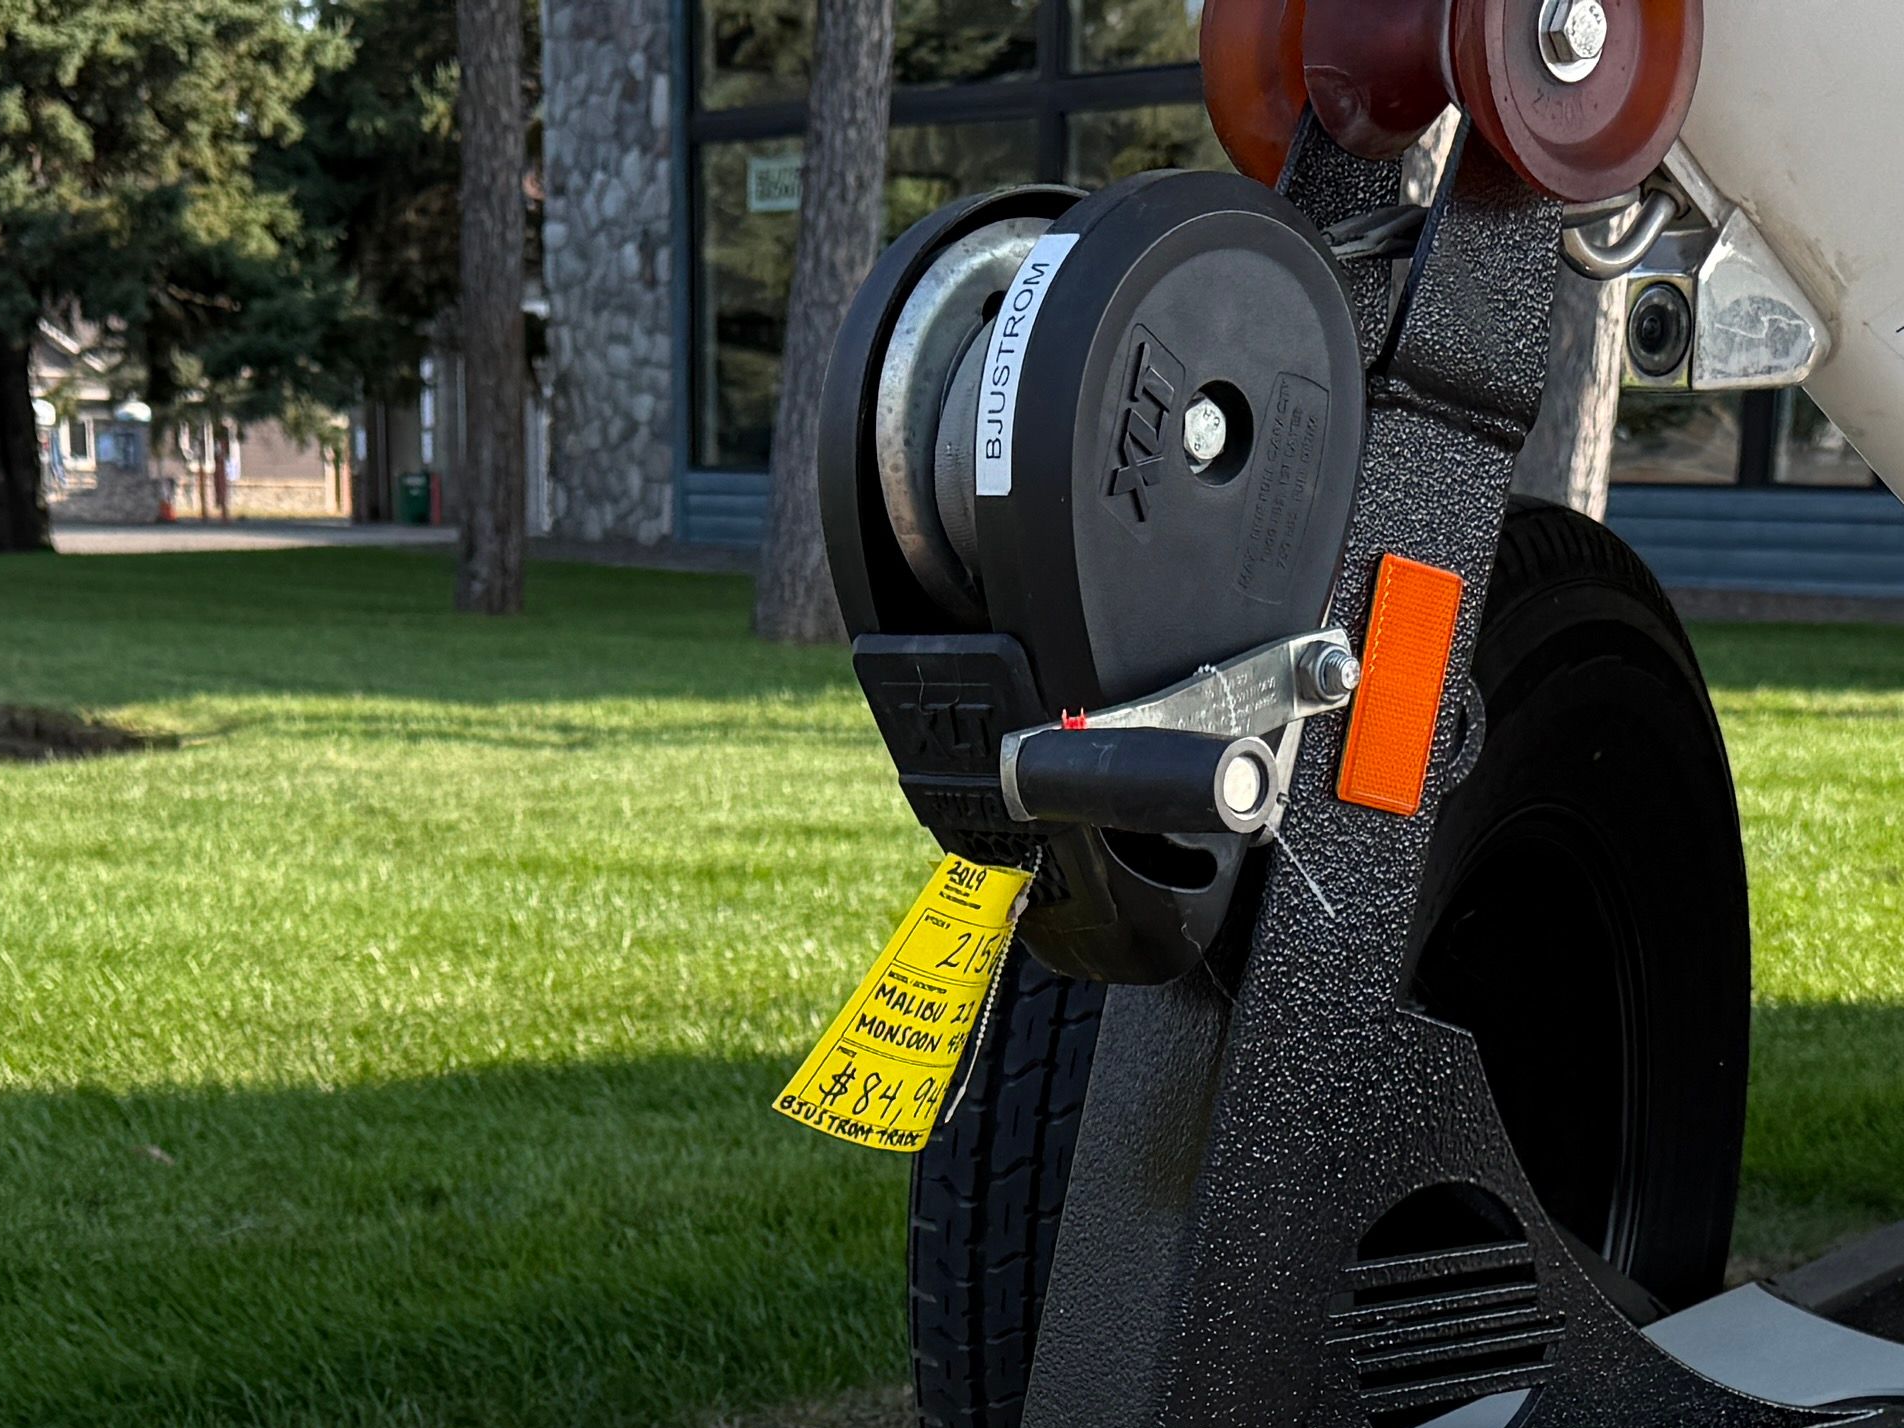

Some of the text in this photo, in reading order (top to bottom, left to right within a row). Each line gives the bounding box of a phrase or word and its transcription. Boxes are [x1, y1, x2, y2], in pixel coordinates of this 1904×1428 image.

[985, 260, 1051, 460] BJUSTROM
[1111, 339, 1175, 523] XLT
[947, 860, 987, 892] 2019
[874, 982, 949, 1024] MALIBU
[855, 1013, 944, 1054] MONSOON
[818, 1060, 947, 1127] $84,94
[778, 1094, 874, 1146] BJUSTROM
